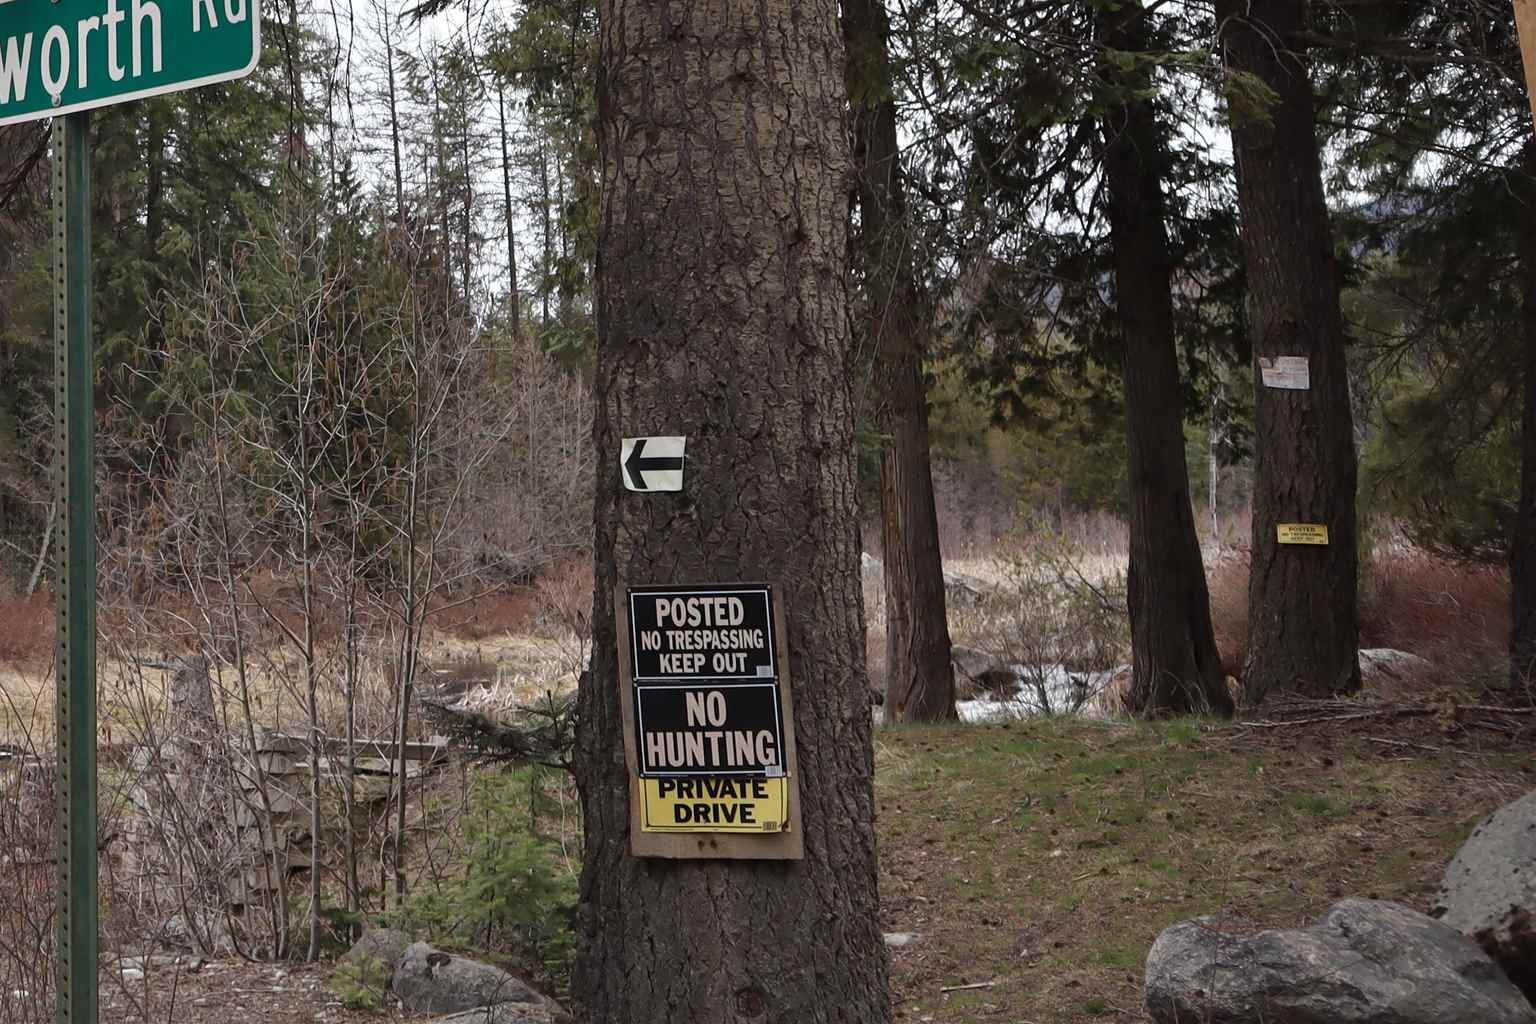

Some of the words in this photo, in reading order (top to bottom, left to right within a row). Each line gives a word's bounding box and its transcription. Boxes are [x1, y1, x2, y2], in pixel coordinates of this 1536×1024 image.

[655, 597, 744, 628] POSTED
[641, 630, 662, 651] NO
[666, 629, 764, 651] TRESPASSING
[659, 653, 706, 674] KEEP
[713, 652, 748, 673] OUT
[685, 690, 727, 727] NO
[646, 730, 777, 768] HUNTING
[658, 777, 769, 800] PRIVATE
[673, 803, 756, 824] DRIVE
